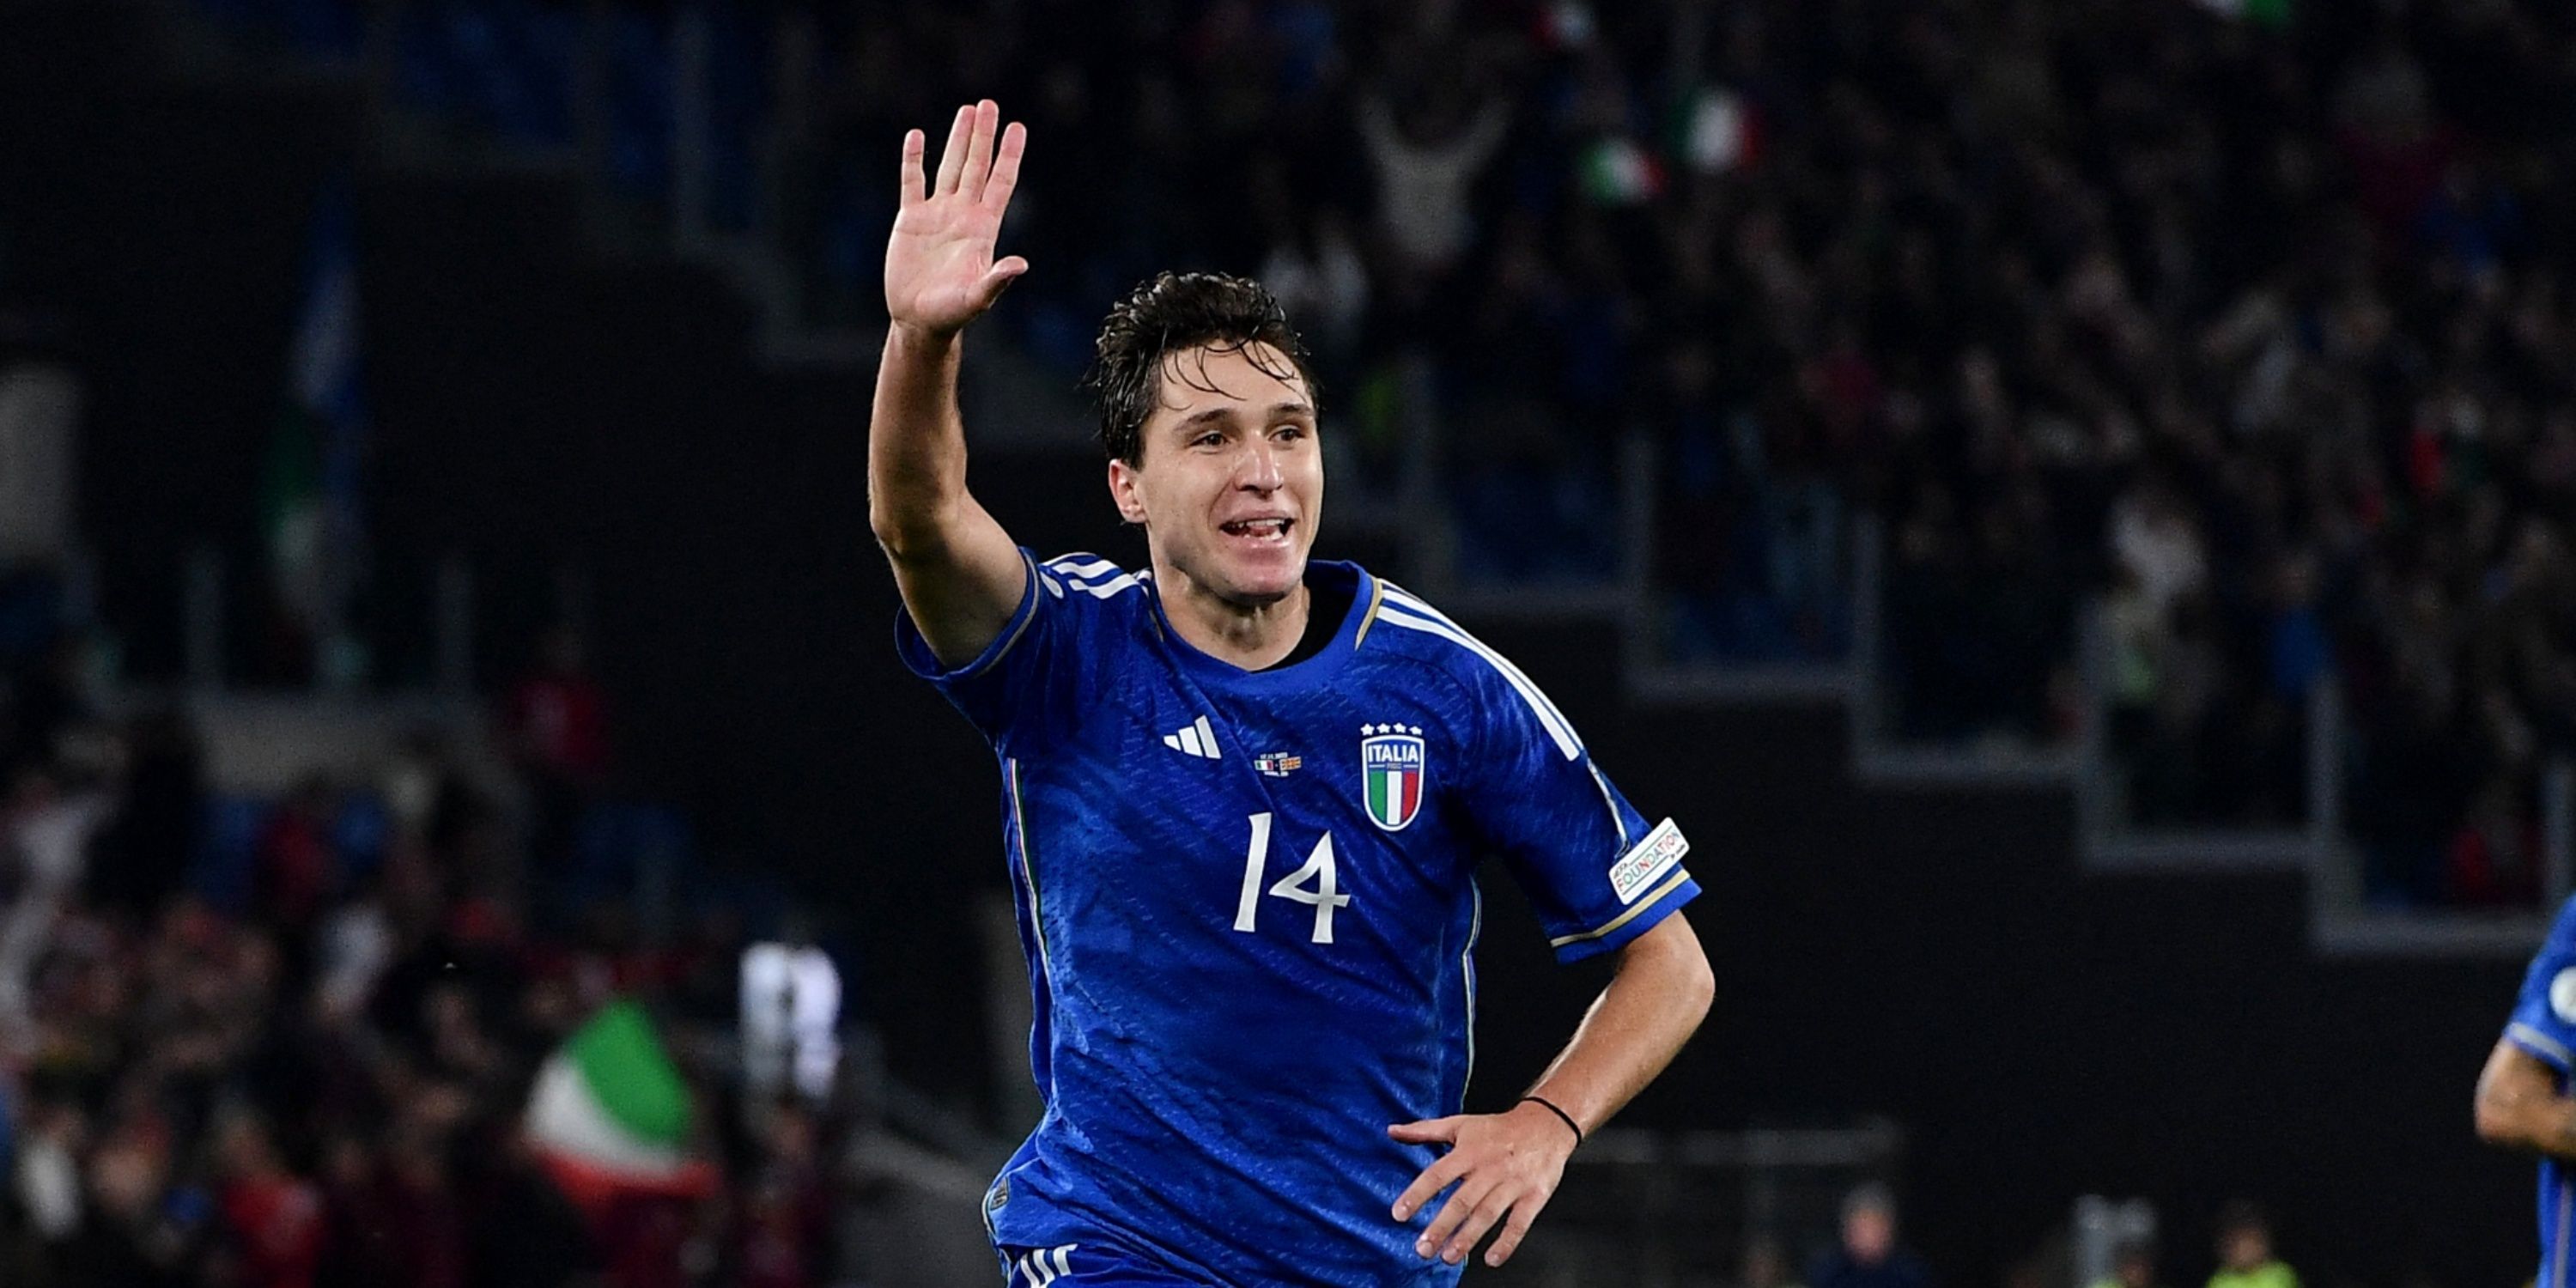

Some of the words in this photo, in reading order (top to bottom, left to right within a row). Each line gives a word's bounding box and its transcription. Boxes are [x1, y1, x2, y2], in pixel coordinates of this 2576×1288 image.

[1368, 744, 1419, 762] ITALIA
[1233, 811, 1351, 944] 14
[1616, 830, 1680, 892] FOUNDATION
